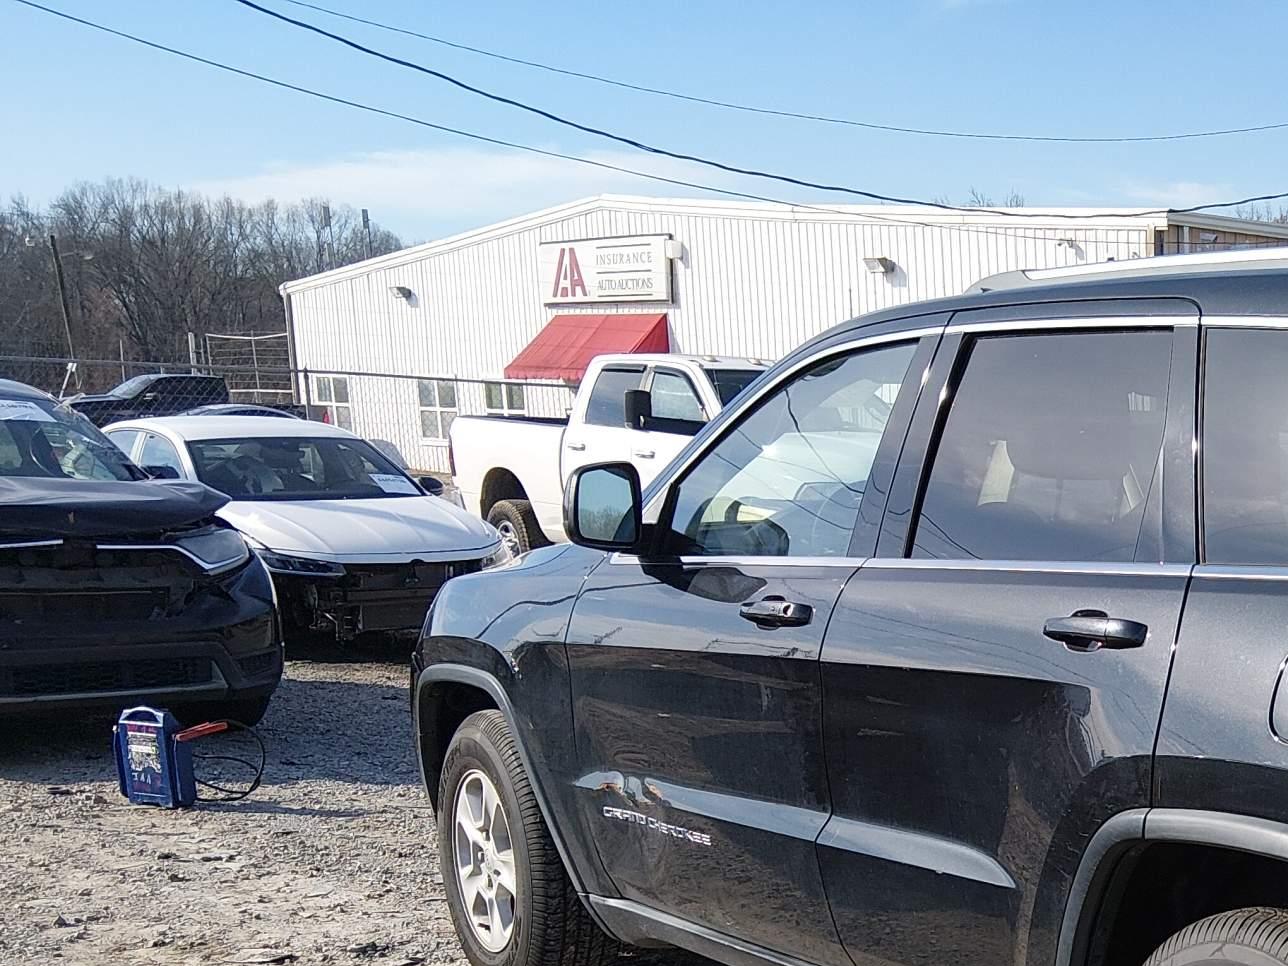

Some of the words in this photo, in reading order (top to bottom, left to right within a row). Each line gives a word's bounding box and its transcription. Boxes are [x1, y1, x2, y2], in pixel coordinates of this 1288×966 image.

[595, 251, 653, 266] INSURANCE
[598, 278, 617, 291] AUTO
[617, 277, 654, 291] AUCTIONS
[602, 806, 647, 826] GRAND
[647, 817, 712, 847] CHEROKEE
